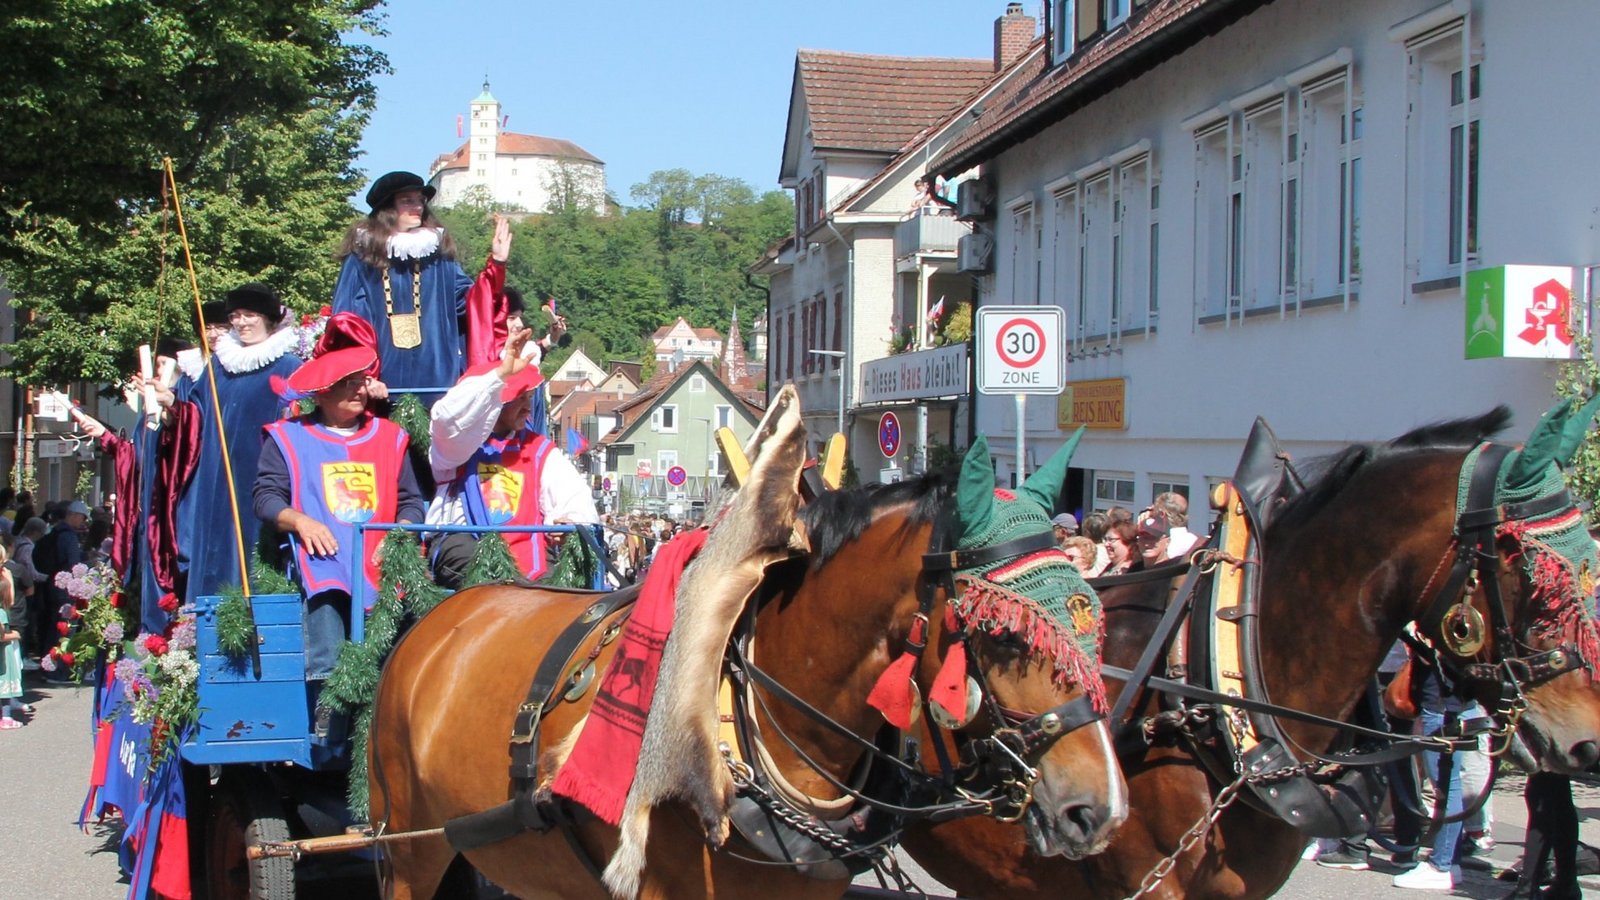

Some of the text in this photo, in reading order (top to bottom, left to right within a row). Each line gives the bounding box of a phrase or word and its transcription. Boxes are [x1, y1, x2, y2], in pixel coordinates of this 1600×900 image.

[1007, 332, 1036, 355] 30
[871, 353, 960, 395] Dieses Haus bleibt!
[1002, 371, 1041, 384] ZONE
[1073, 400, 1121, 423] REIS KING
